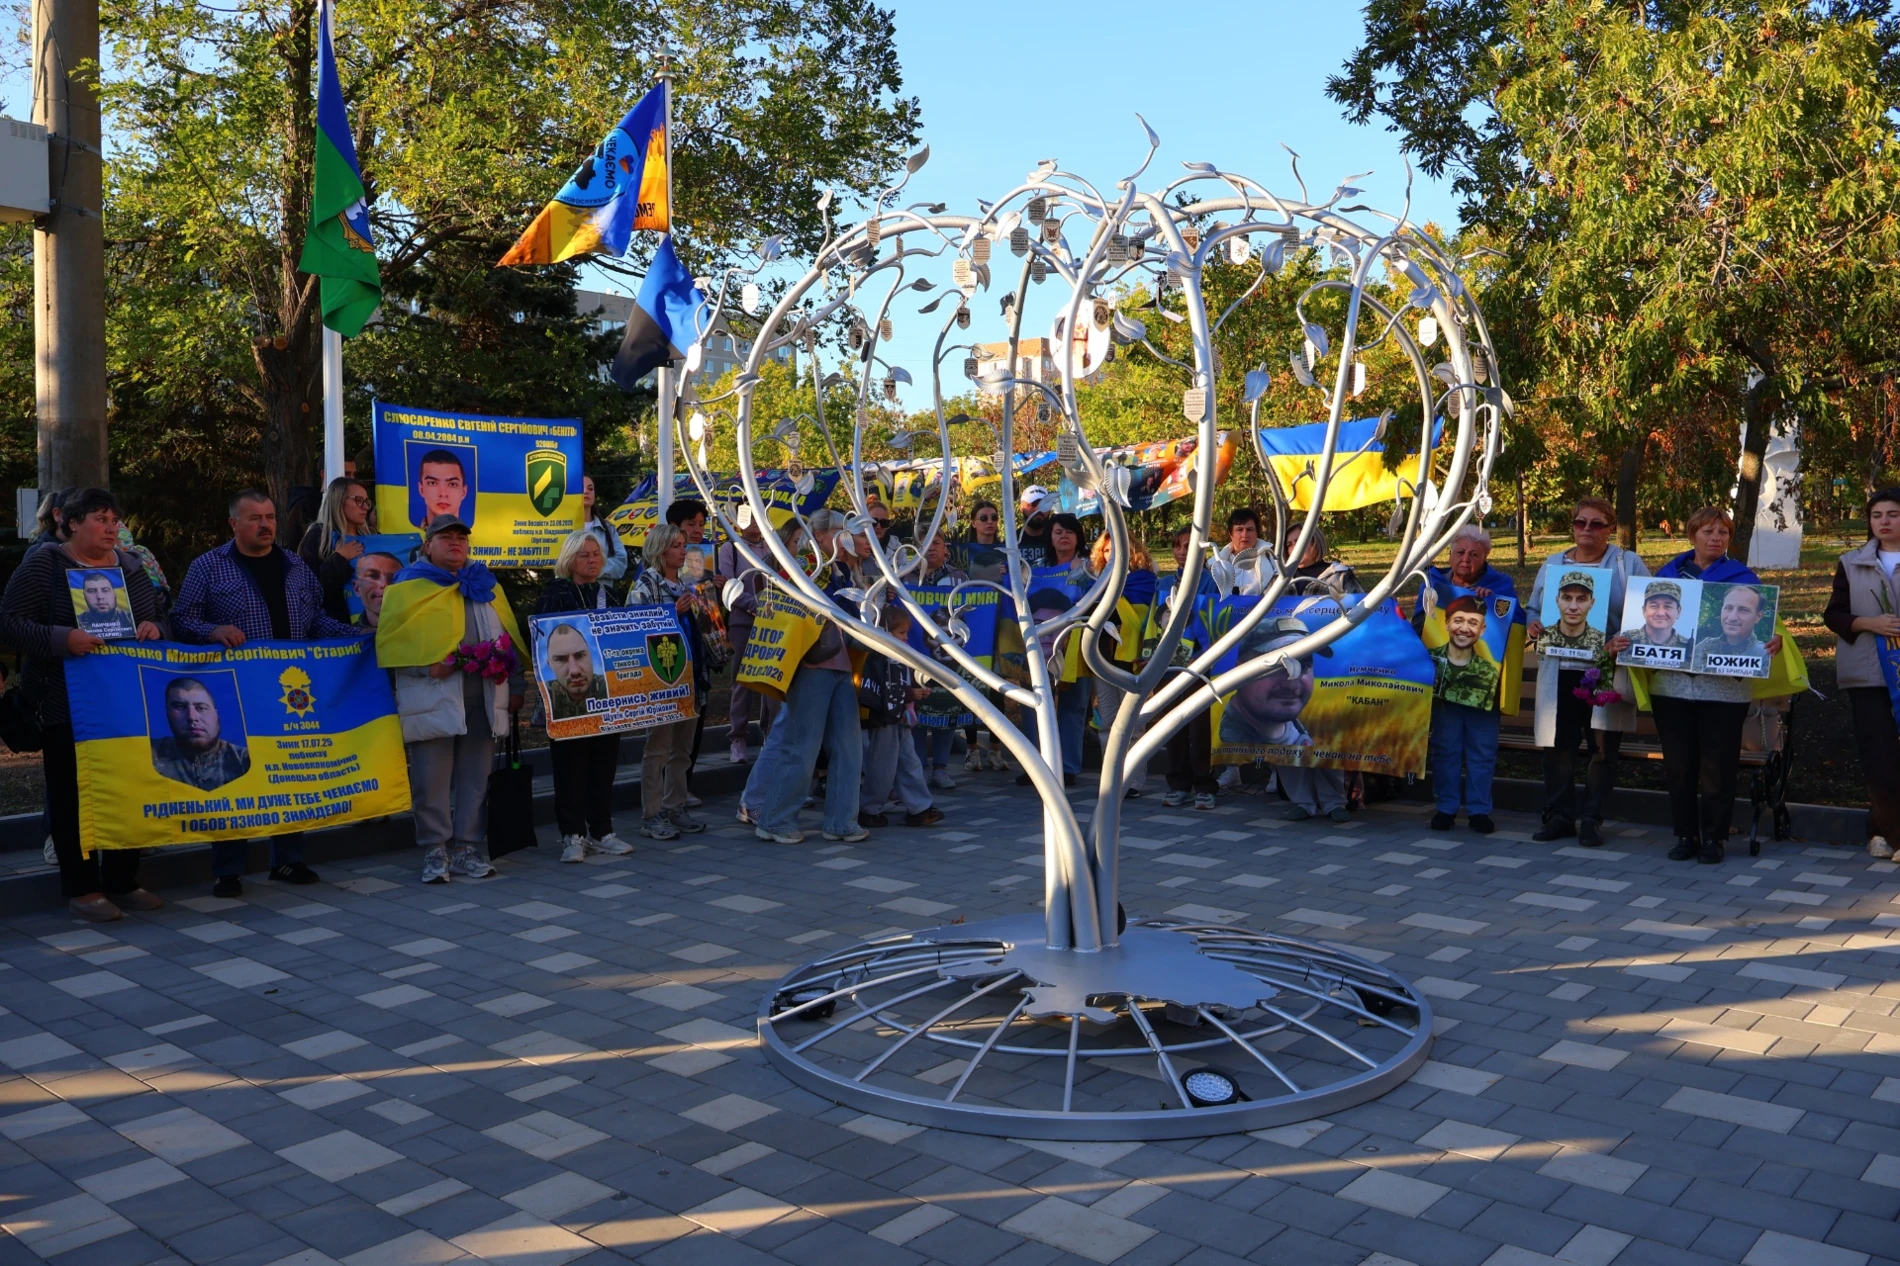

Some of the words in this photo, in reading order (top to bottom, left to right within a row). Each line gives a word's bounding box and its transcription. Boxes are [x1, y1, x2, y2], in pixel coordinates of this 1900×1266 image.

[605, 136, 617, 189] ЧЕКАЄМО
[383, 411, 456, 429] СЛЮСАРЕНКО
[457, 419, 497, 433] ЄВГЕНІЙ
[498, 421, 549, 436] СЕРГІЙОВИЧ
[412, 430, 457, 443] 08.04.2004
[472, 547, 502, 556] ЗНИКЛІ
[507, 547, 516, 556] НЕ
[518, 547, 541, 556] ЗАБУТІ
[588, 611, 627, 622] Безвісти
[628, 607, 663, 618] зниклий
[592, 627, 602, 635] не
[604, 623, 640, 633] значить
[641, 619, 676, 630] забутий!
[166, 648, 222, 664] Микола
[225, 648, 306, 662] Сергійович
[307, 642, 364, 660] "Старий"
[621, 647, 645, 657] окрема
[1634, 646, 1682, 660] БАТЯ
[613, 659, 639, 668] танкова
[1708, 656, 1761, 668] ЮЖИК
[616, 671, 642, 680] бригада
[1349, 665, 1396, 675] Немченко
[1357, 678, 1424, 694] Миколайович
[587, 694, 647, 711] Повернись
[649, 685, 690, 701] живий!
[1346, 695, 1389, 706] "КАБАН"
[624, 707, 645, 719] Сергій
[646, 703, 677, 715] Юрійович
[283, 722, 299, 731] в/ч
[300, 721, 320, 730] 3044
[277, 740, 299, 749] Зник
[301, 738, 333, 748] 17.07.25
[289, 750, 327, 760] поблизу
[1267, 746, 1304, 758] подиху
[1313, 750, 1347, 760] чекаю
[1348, 752, 1362, 760] на
[1364, 754, 1392, 765] тебе
[268, 774, 317, 784] (Донецька
[318, 763, 360, 780] область)
[143, 796, 235, 818] РІДНЕНЬКИЙ,
[236, 797, 255, 811] МИ
[257, 794, 293, 811] ДУЖЕ
[293, 791, 322, 805] ТЕБЕ
[323, 777, 379, 801] ЧЕКАЄМО
[181, 820, 186, 833] І
[189, 813, 280, 832] ОБОВ'ЯЗКОВО
[283, 800, 353, 824] ЗНАЙДЕМО!
